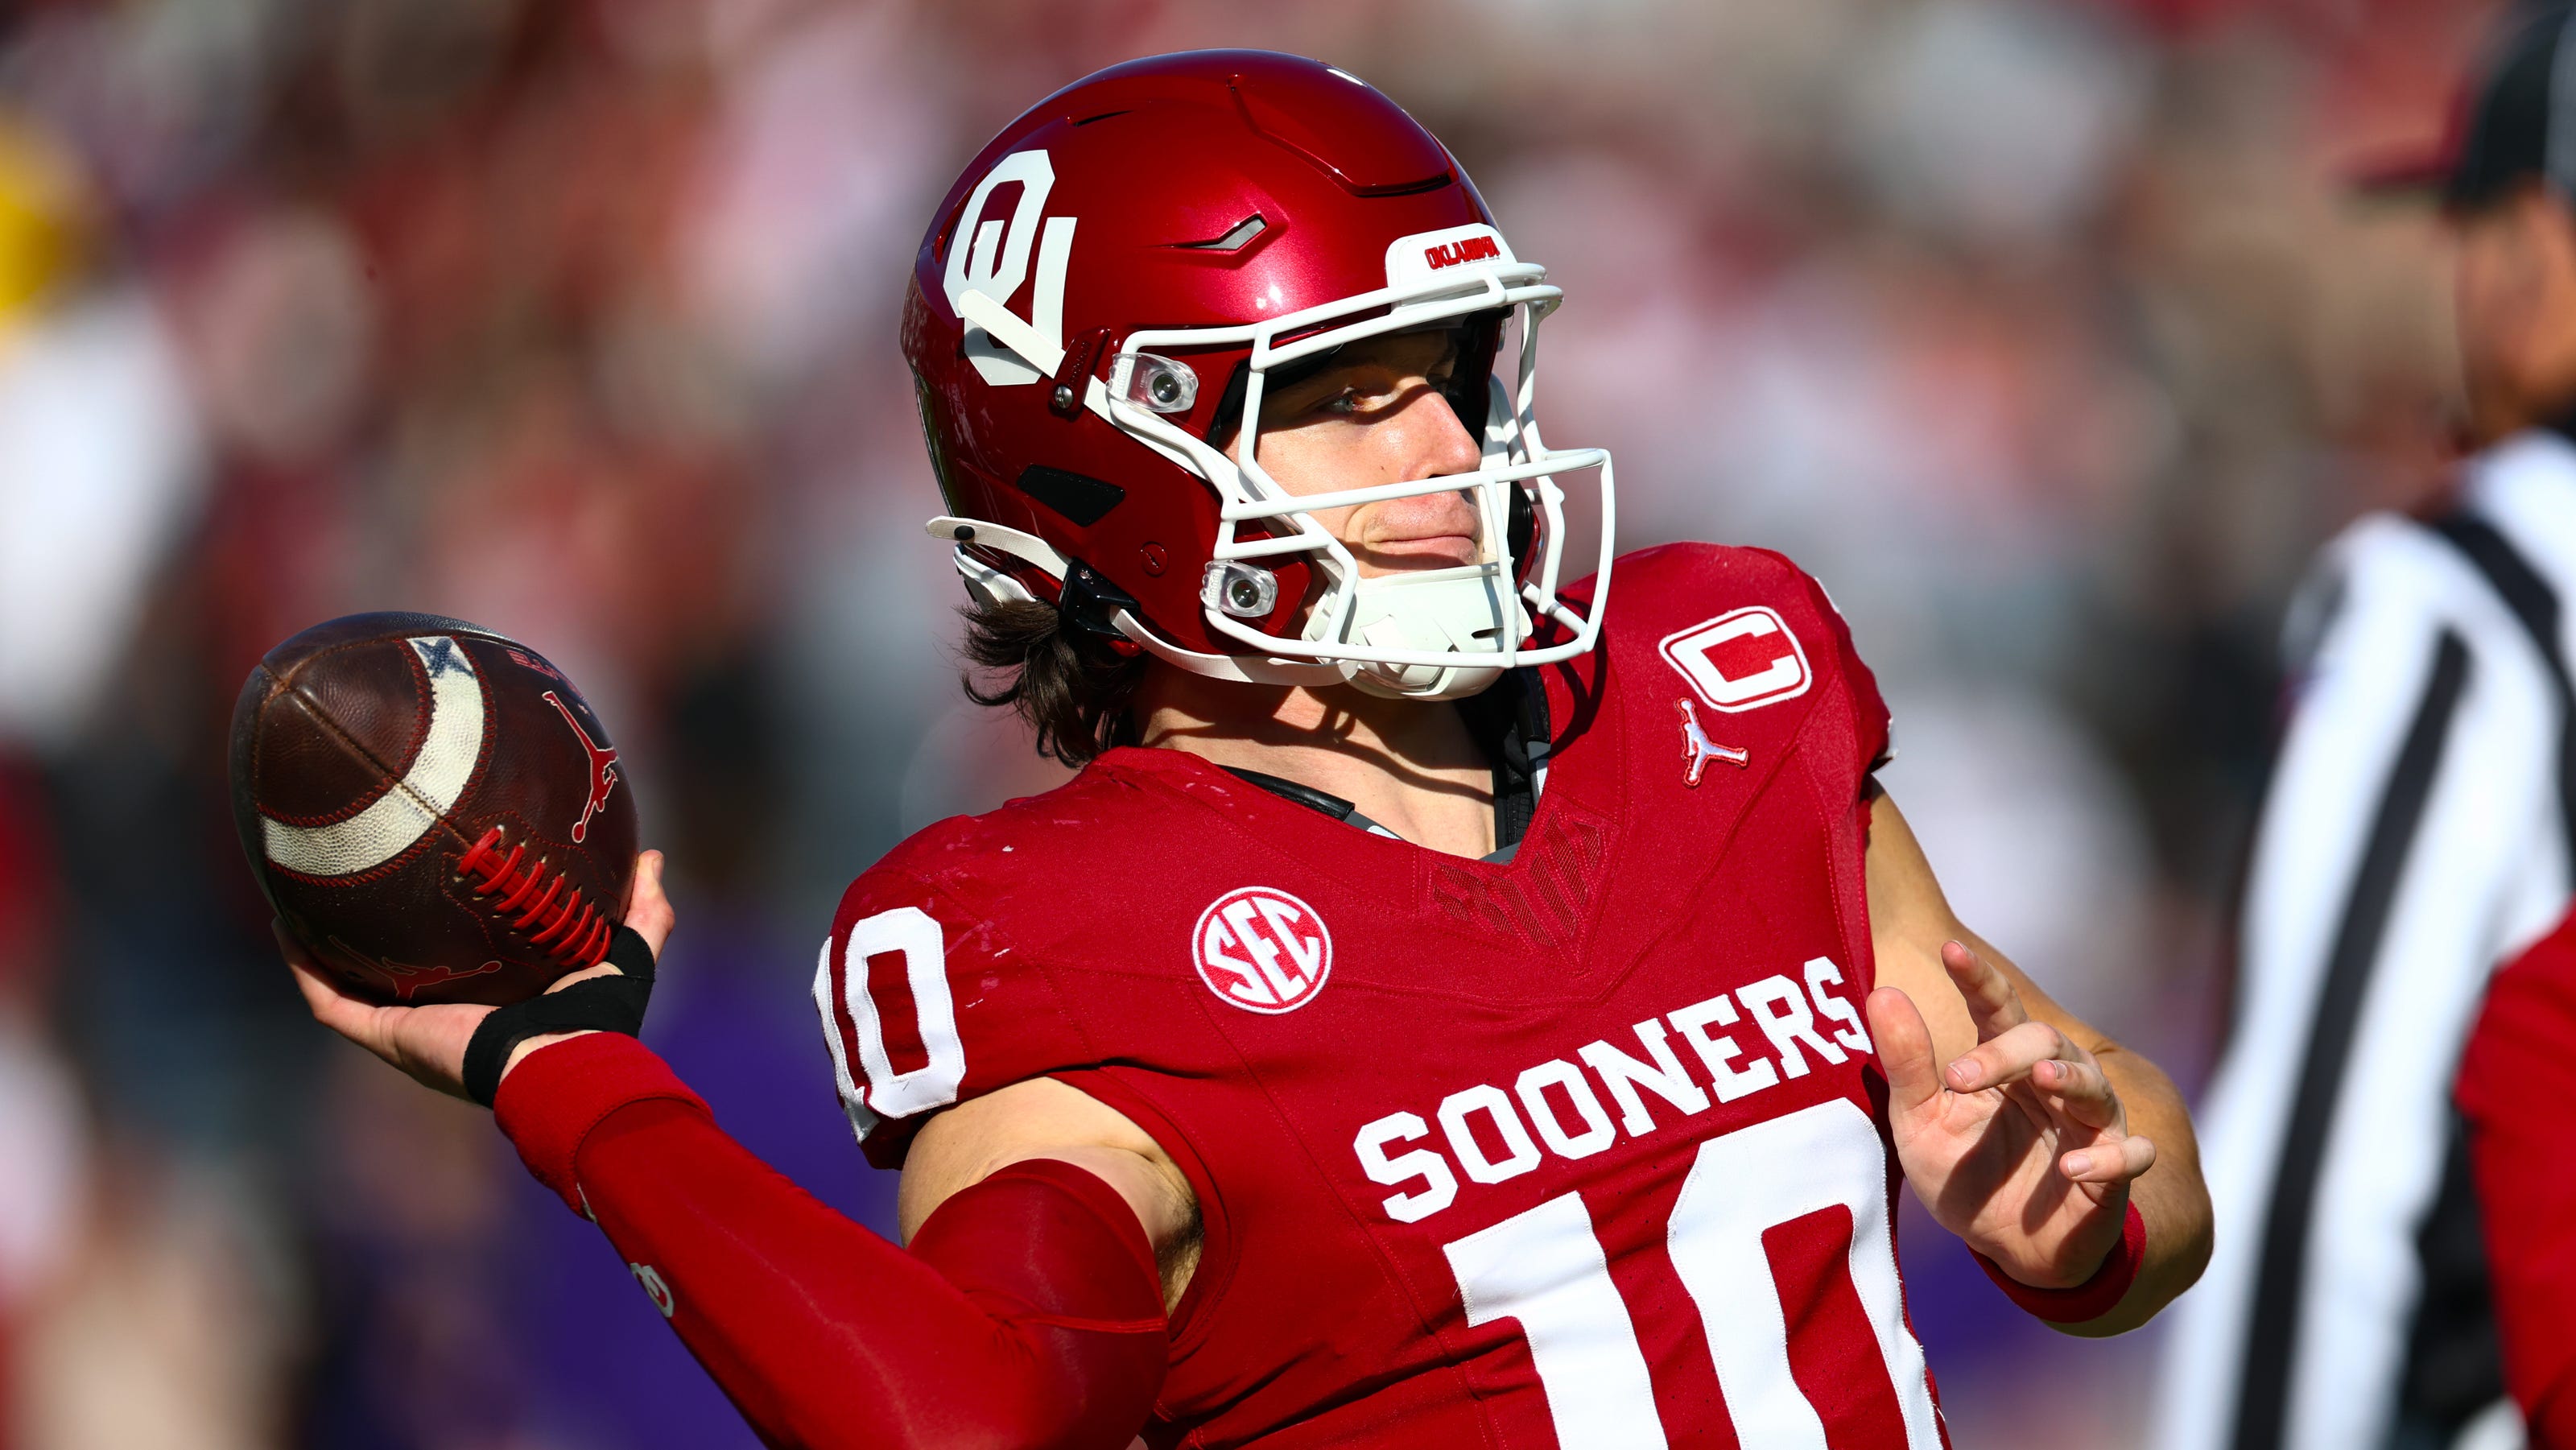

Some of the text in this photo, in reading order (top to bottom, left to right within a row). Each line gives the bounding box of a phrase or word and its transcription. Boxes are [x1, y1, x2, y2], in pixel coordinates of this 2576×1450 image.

[1669, 613, 1802, 704] C
[1203, 896, 1321, 1005] SEC
[1352, 956, 1873, 1224] SOONERS
[1442, 1097, 1944, 1450] 10
